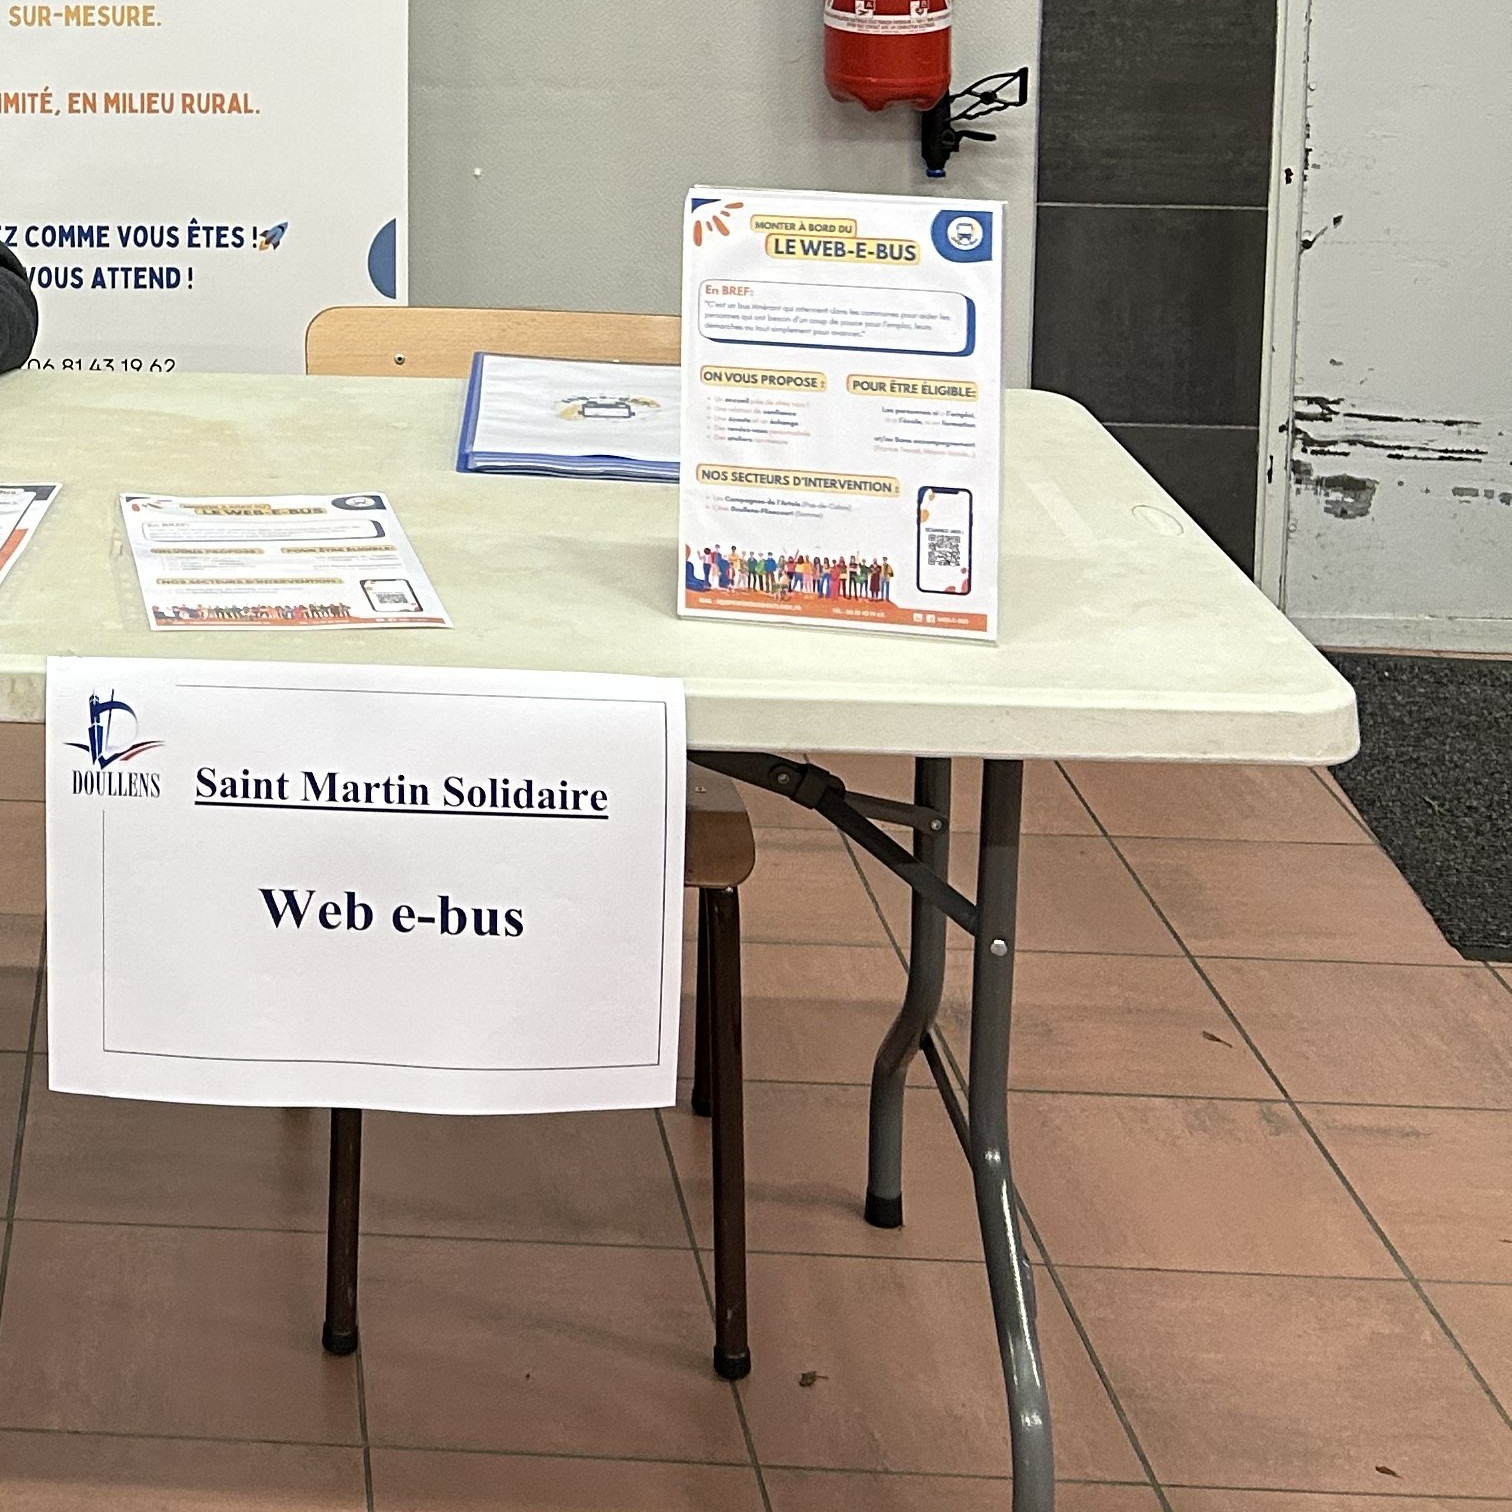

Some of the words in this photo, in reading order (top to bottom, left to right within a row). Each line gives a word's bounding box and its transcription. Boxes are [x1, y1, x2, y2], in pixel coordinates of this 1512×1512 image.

[9, 5, 162, 28] SUR-MESURE.
[67, 93, 97, 115] EN
[103, 92, 175, 115] MILIEU
[181, 92, 261, 115] RURAL.
[25, 224, 110, 248] COMME
[118, 224, 180, 248] VOUS
[187, 218, 245, 248] ÊTES
[251, 224, 258, 248] !
[798, 220, 806, 231] À
[808, 222, 836, 233] BORD
[838, 223, 854, 234] DU
[774, 238, 796, 256] LE
[801, 239, 917, 262] WEB-E-BUS
[29, 266, 84, 289] VOUS
[91, 265, 182, 289] ATTEND
[186, 265, 194, 289] !
[705, 285, 719, 295] En
[62, 358, 82, 371] 81
[89, 358, 115, 372] 43
[121, 358, 143, 372] 19
[149, 358, 176, 373] 62
[703, 370, 722, 382] ON
[724, 371, 758, 385] VOUS
[761, 374, 818, 388] PROPOSE
[853, 379, 887, 393] POUR
[889, 378, 918, 395] ÊTRE
[701, 469, 727, 482] NOS
[731, 471, 790, 486] SECTEURS
[793, 476, 892, 493] D'INTERVENTION
[223, 507, 324, 516] WEB-E-BUS
[72, 769, 160, 798] DOULLENS
[195, 767, 290, 803] Saint
[301, 770, 430, 807] Martin
[443, 776, 609, 813] Solidaire
[259, 888, 373, 932] Web
[392, 895, 525, 938] e-bus
